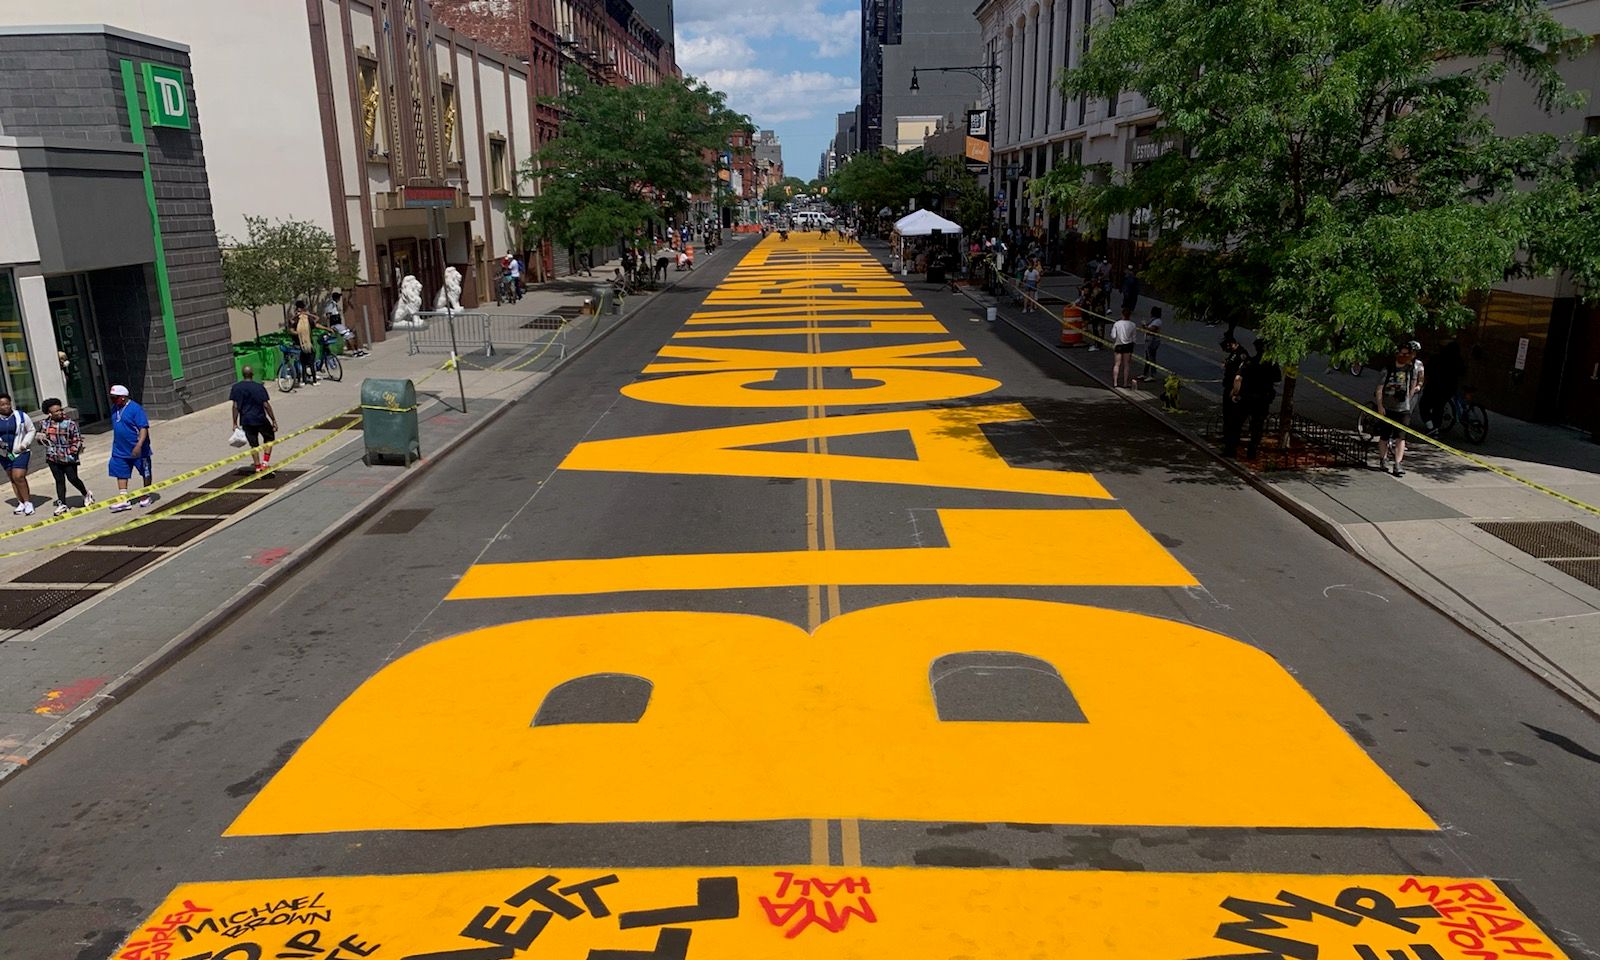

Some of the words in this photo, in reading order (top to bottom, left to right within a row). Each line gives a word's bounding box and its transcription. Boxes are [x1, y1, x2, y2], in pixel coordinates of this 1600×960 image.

[153, 75, 185, 117] TD
[723, 243, 895, 282] MATTE
[671, 279, 950, 339] LIVES
[222, 340, 1438, 837] BLACK
[773, 871, 871, 898] HALL
[178, 891, 326, 943] MICHAEL
[221, 909, 331, 939] BROWN
[758, 896, 878, 939] MYA
[1445, 882, 1555, 959] RIAH
